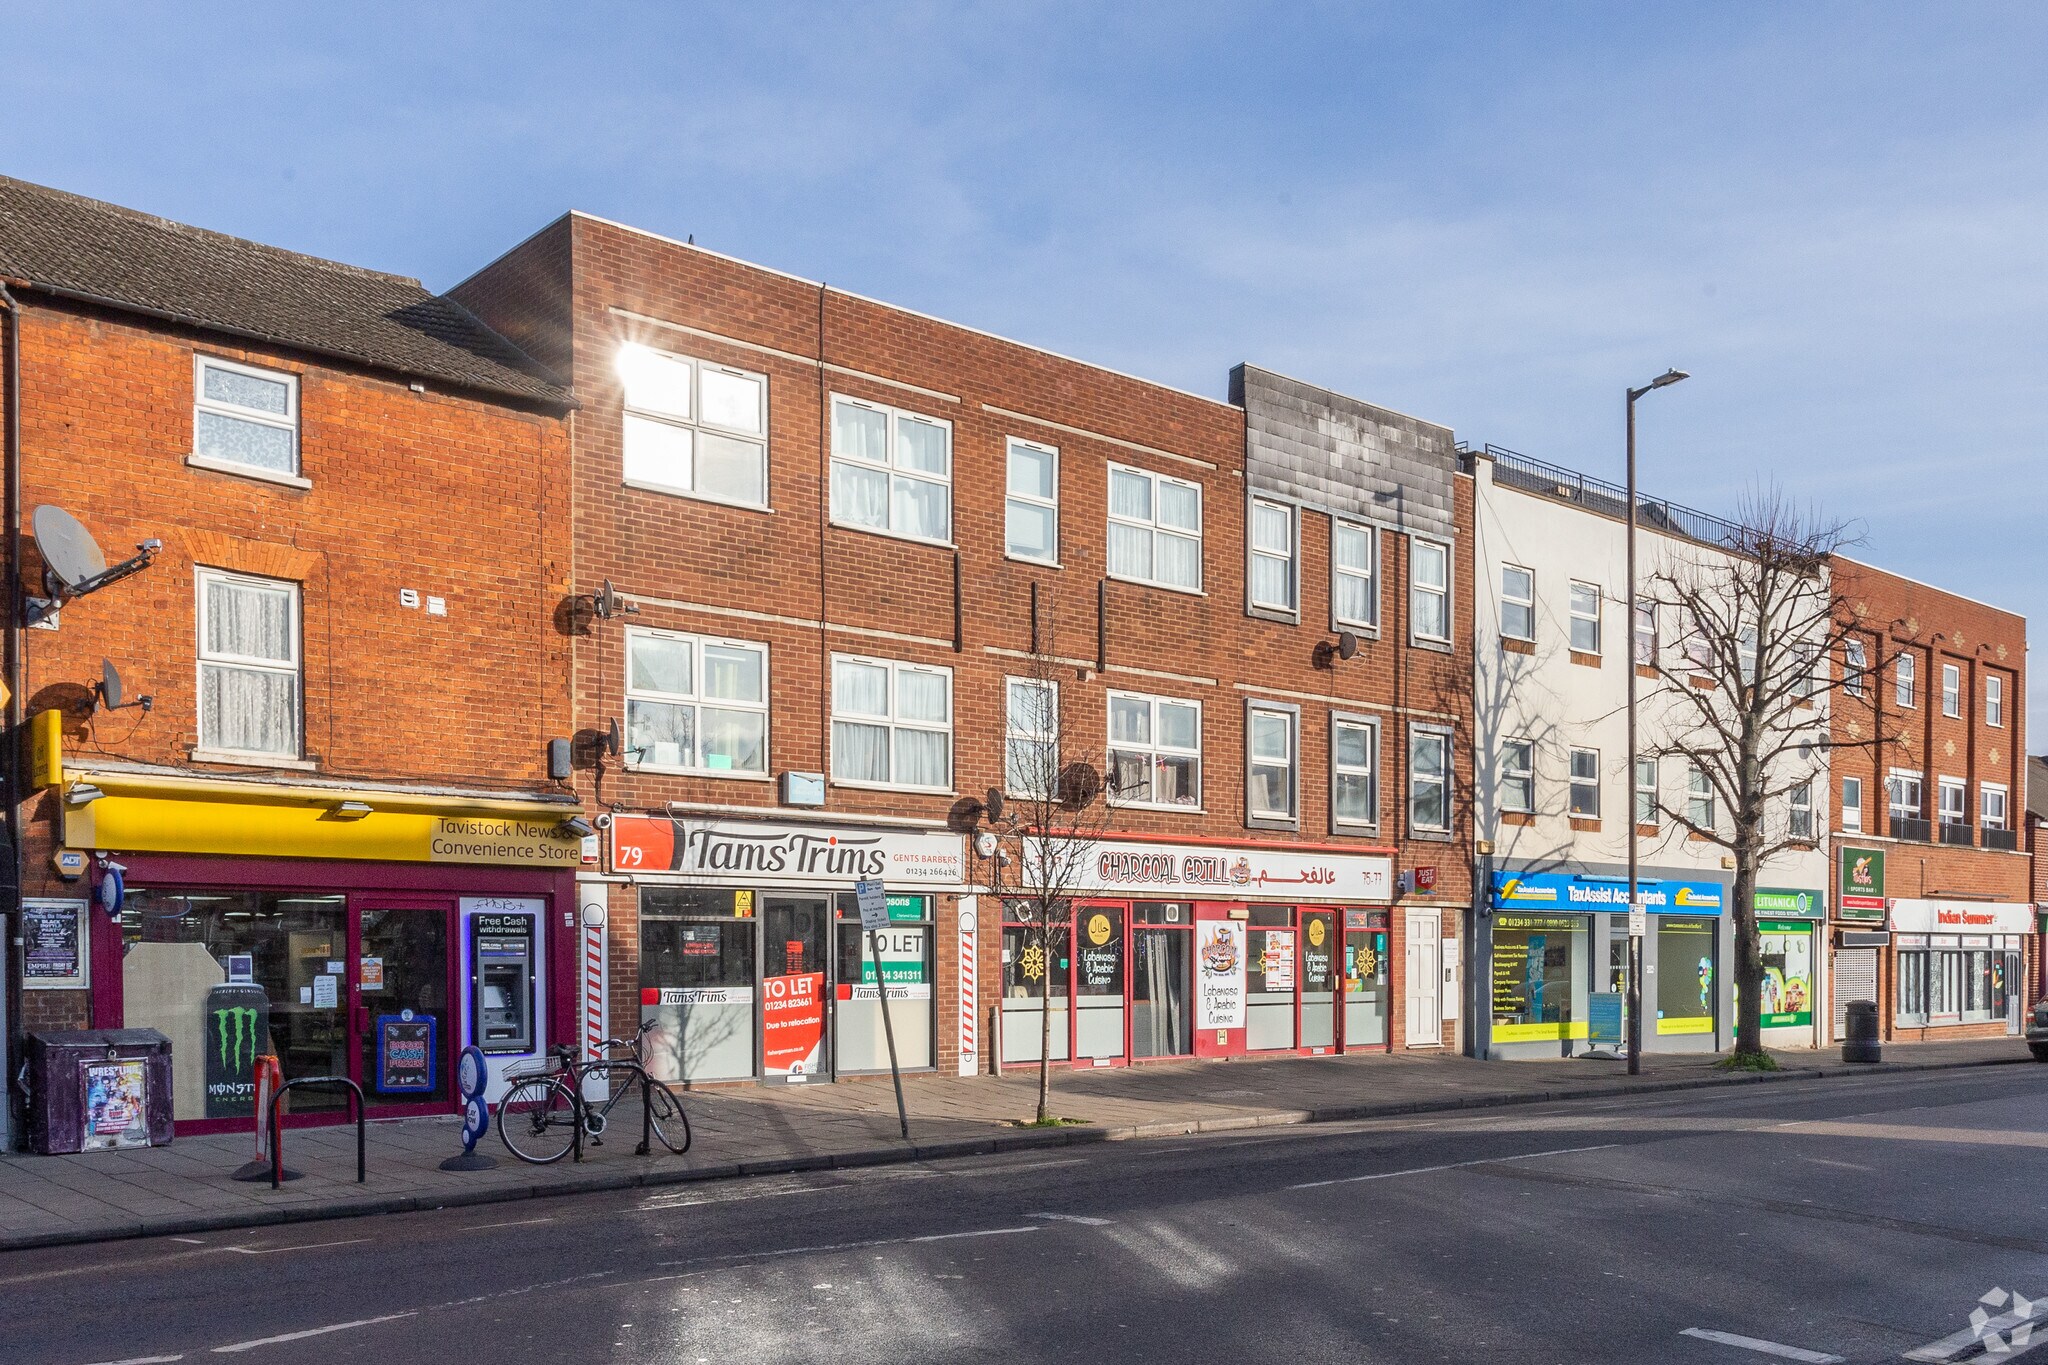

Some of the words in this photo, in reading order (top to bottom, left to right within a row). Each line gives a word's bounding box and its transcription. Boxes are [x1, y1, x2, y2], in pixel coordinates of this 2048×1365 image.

[438, 818, 510, 836] Tavistock
[515, 822, 563, 838] News
[432, 838, 535, 859] Convenience
[538, 843, 579, 860] Store
[689, 829, 791, 871] Tams
[788, 834, 887, 876] Trims
[62, 856, 81, 866] ADT
[620, 846, 644, 866] 79
[893, 853, 920, 864] GENTS
[921, 855, 959, 866] BARBERS
[906, 867, 929, 877] 01234
[929, 867, 958, 877] 266426
[1098, 852, 1180, 884] CHARCOAL
[1182, 856, 1231, 886] GRILL
[1418, 868, 1434, 878] JUST
[1421, 876, 1434, 884] EAT
[1568, 885, 1612, 902] TaxAssist
[1757, 897, 1796, 908] LITUANICA
[479, 916, 501, 926] Free
[503, 916, 527, 926] Cash
[1508, 918, 1523, 926] 01234
[1937, 909, 1961, 924] Indian
[1962, 910, 1995, 925] Summer
[479, 925, 527, 933] withdrawals
[866, 934, 887, 953] TO
[893, 934, 923, 953] LET
[1083, 950, 1116, 962] Lebanese
[1305, 951, 1328, 962] Lebanese
[1092, 961, 1115, 974] Arabic
[865, 970, 891, 980] 0134
[893, 970, 922, 980] 341311
[764, 980, 786, 998] TO
[790, 977, 813, 996] LET
[855, 987, 881, 998] Tams
[881, 986, 909, 999] rims
[1203, 983, 1239, 997] Lebanese
[664, 990, 697, 1003] Tams
[694, 990, 727, 1003] Trims
[765, 999, 787, 1011] 01234
[788, 997, 813, 1008] 823661
[1206, 1000, 1211, 1010] &
[1213, 997, 1237, 1011] Arabic
[766, 1021, 780, 1030] Due
[788, 1017, 820, 1027] relocation
[1208, 1013, 1234, 1024] Cuisine
[1218, 1031, 1226, 1043] H
[389, 1049, 425, 1059] CASH
[389, 1060, 425, 1068] PRIZES
